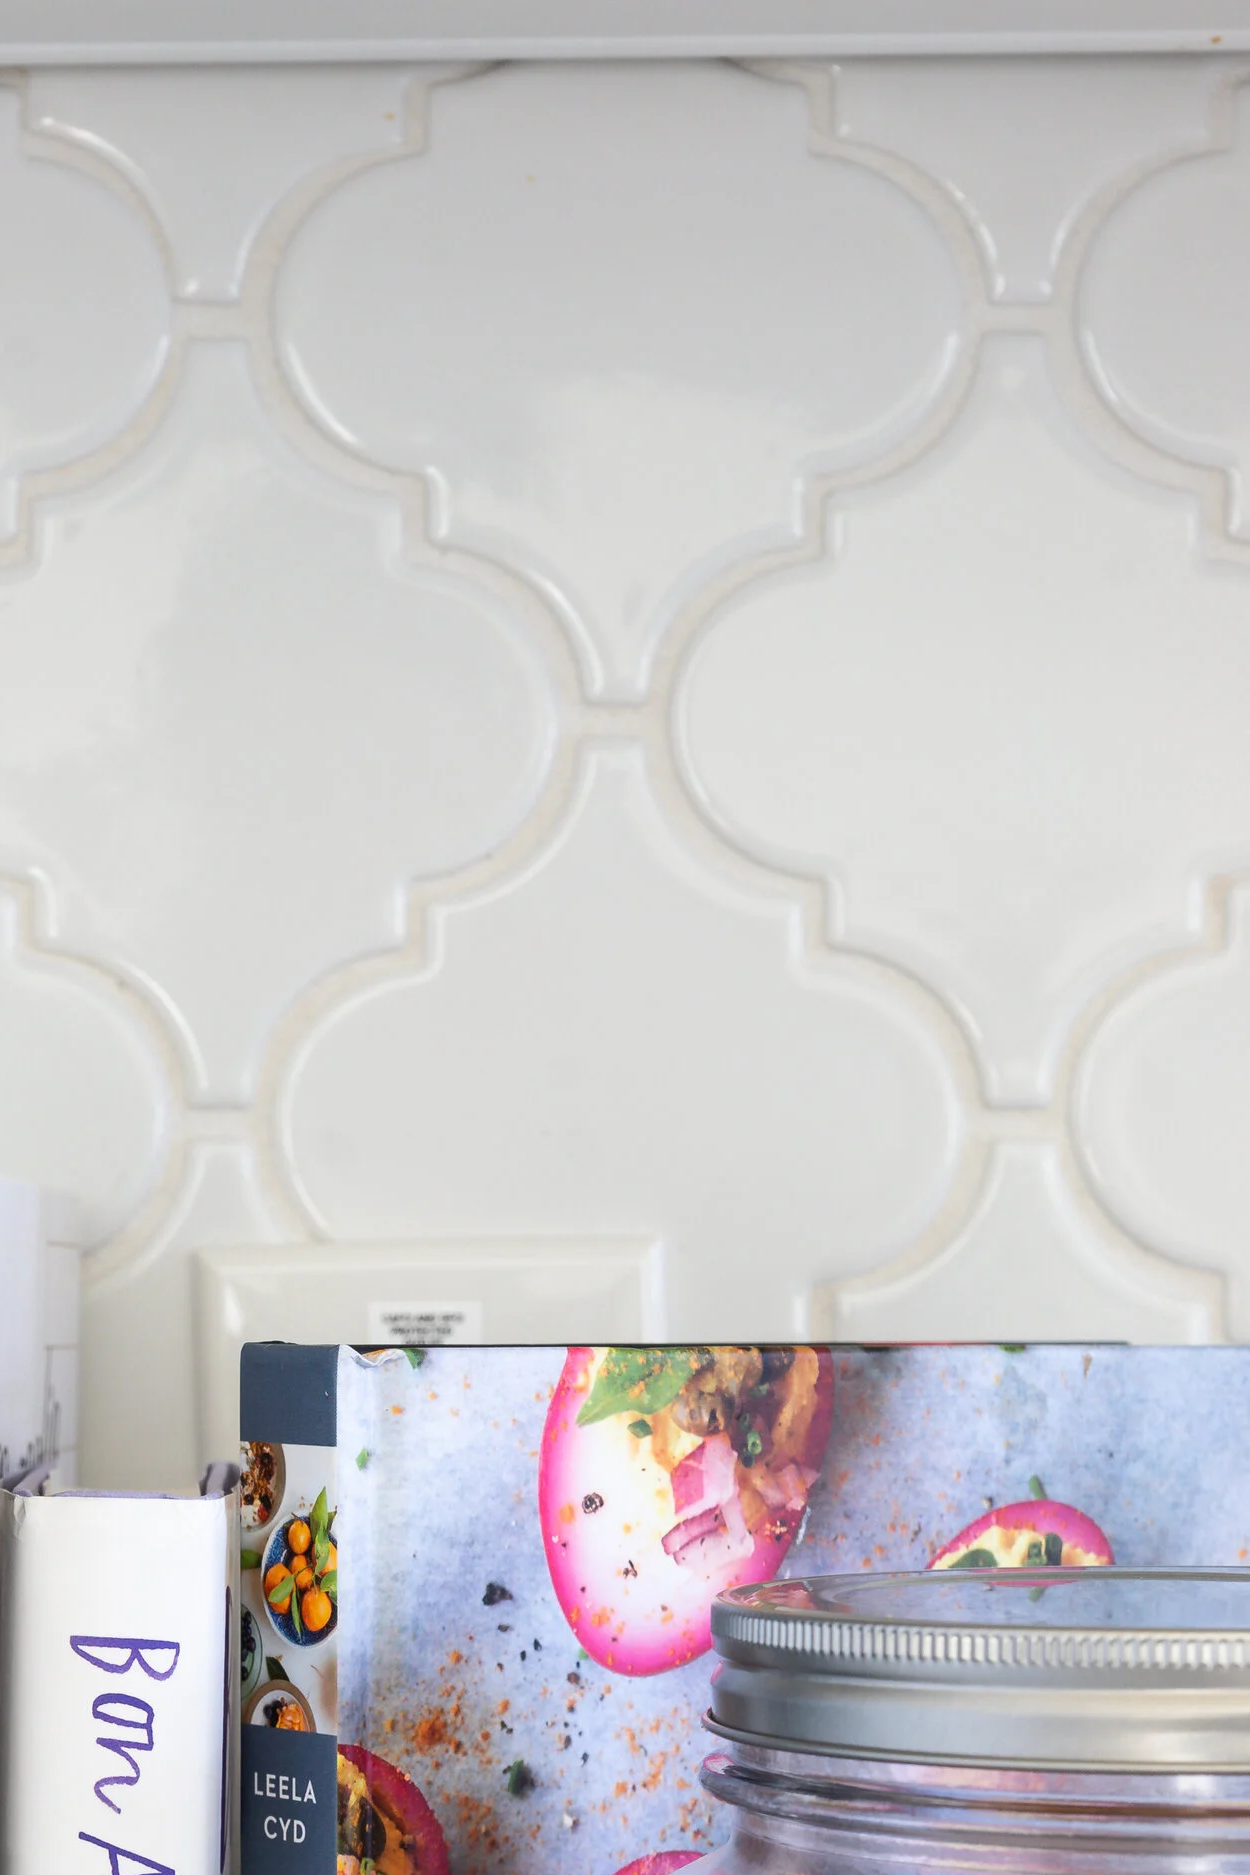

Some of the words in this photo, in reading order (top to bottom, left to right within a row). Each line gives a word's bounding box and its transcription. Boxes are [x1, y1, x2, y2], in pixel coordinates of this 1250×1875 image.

[69, 1635, 178, 1812] Bon
[253, 1771, 315, 1803] LEELA
[263, 1815, 305, 1842] CYD
